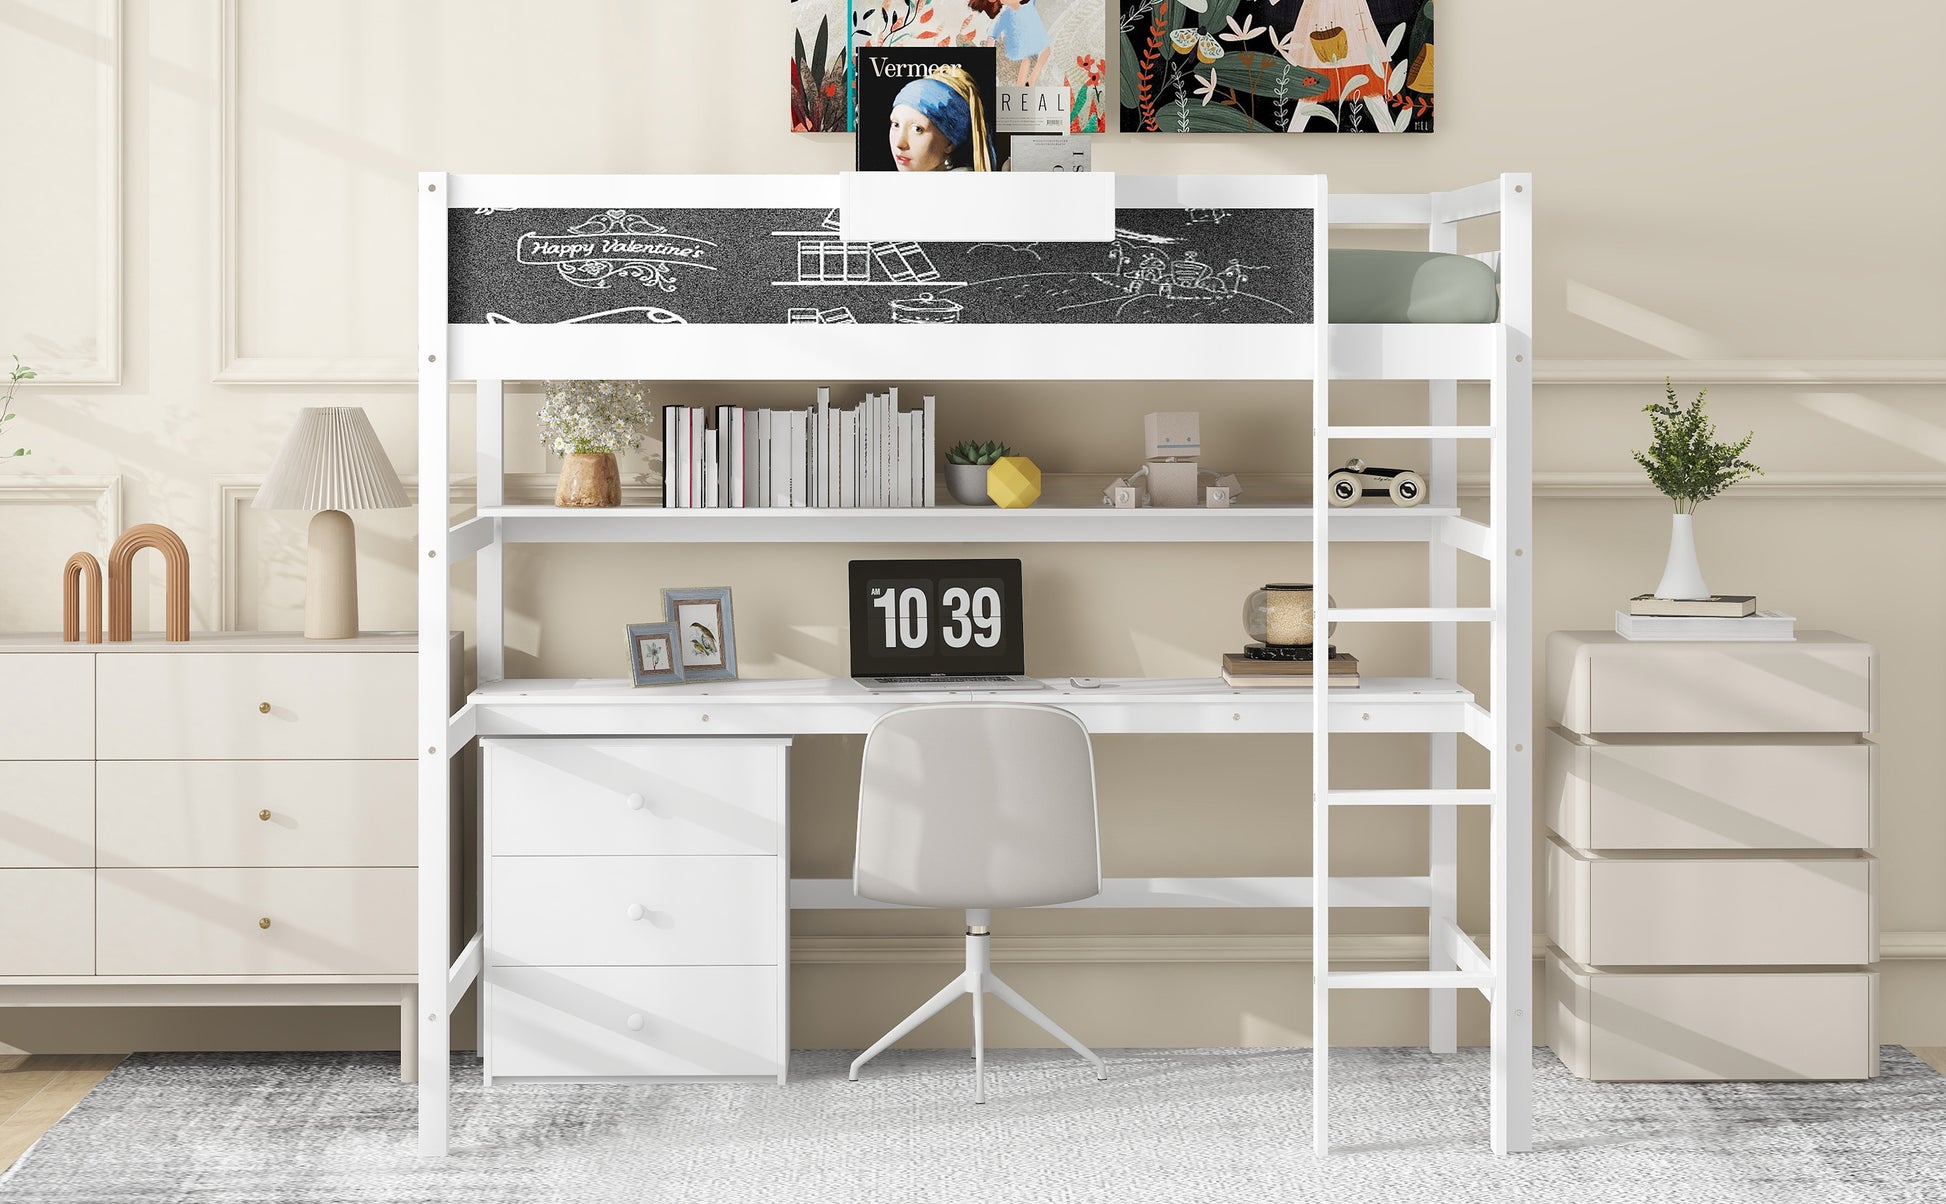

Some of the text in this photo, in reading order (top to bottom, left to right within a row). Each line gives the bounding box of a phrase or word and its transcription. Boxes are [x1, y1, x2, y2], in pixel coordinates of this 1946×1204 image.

[868, 56, 962, 78] Vermeer
[1001, 93, 1065, 112] REAL
[531, 239, 705, 258] Happy Valentine's
[870, 587, 881, 596] AM
[873, 586, 1002, 649] 10 39
